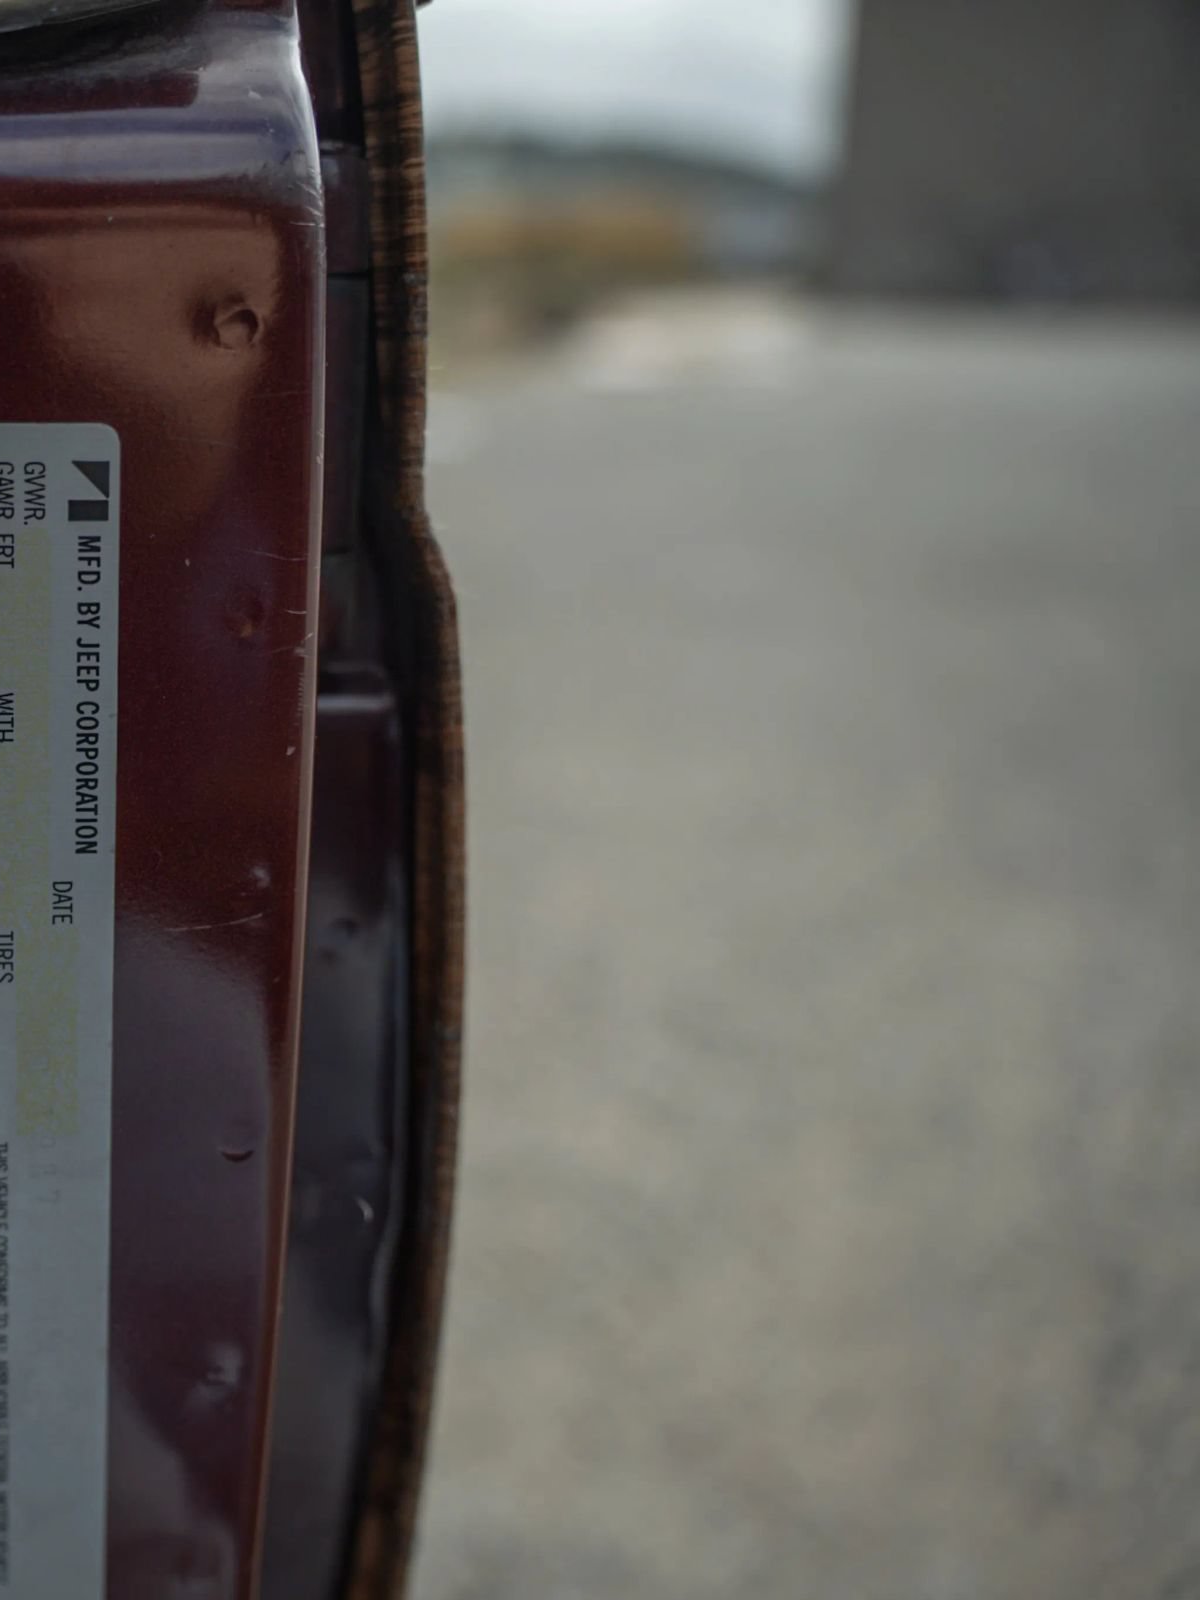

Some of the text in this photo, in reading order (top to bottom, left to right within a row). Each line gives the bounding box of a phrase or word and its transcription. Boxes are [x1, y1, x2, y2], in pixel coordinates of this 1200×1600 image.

[23, 461, 46, 526] GVWR.
[74, 535, 102, 855] MFD. BY JEEP CORPORATION
[51, 880, 74, 925] DATE
